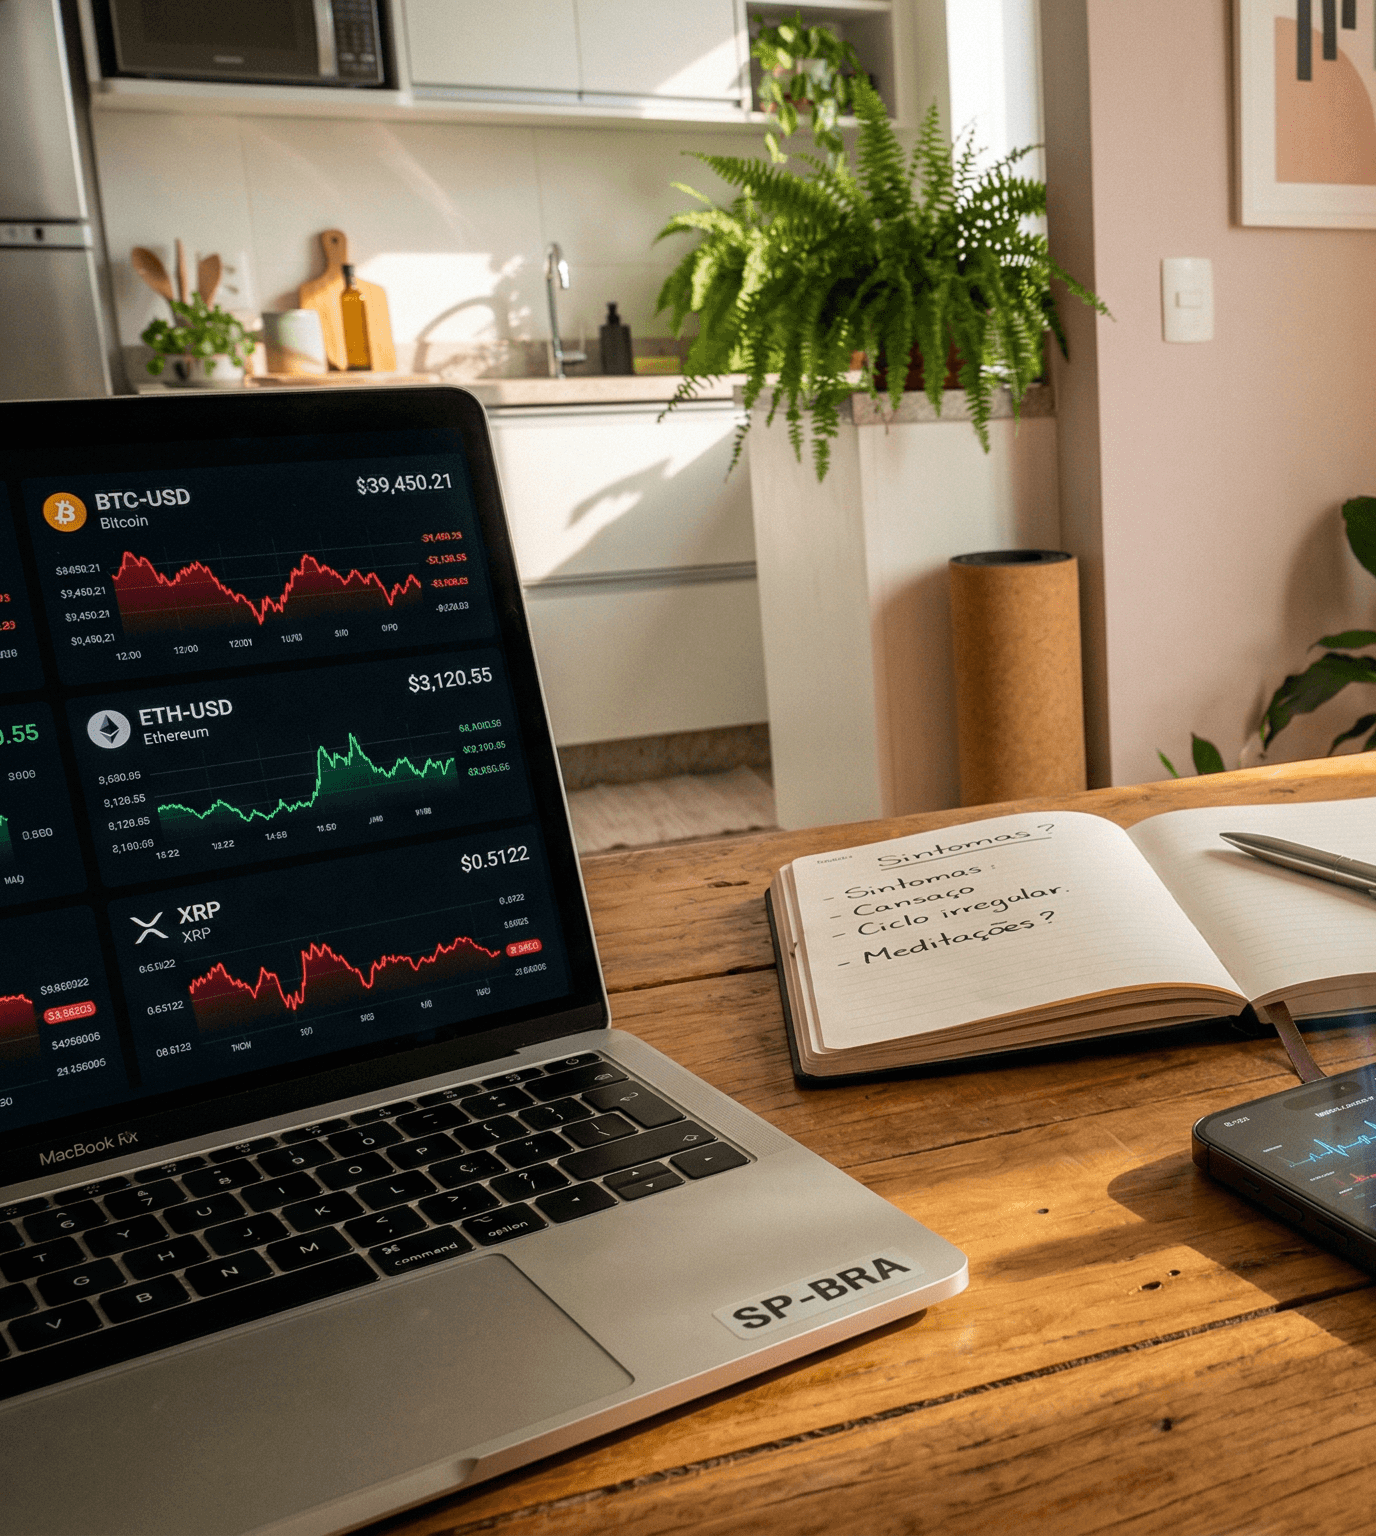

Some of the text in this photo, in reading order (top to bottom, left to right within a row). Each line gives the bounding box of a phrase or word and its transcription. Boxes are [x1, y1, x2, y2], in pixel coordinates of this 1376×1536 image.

[356, 472, 453, 495] $39,450.21
[95, 488, 191, 511] BTC-USD
[100, 514, 149, 530] Bitcoin
[408, 666, 493, 693] $3,120.55
[138, 698, 233, 726] ETH-USD
[143, 727, 210, 745] Ethereum
[877, 831, 1031, 867] Sintomas
[460, 845, 530, 873] $0.5122
[845, 866, 982, 899] Sintomas
[853, 887, 975, 916] Cansaço
[177, 900, 221, 924] XRP
[858, 915, 929, 935] Ciclo
[182, 927, 211, 943] XRP
[864, 920, 1035, 964] Meditações
[39, 1136, 115, 1166] MacBook
[416, 1146, 428, 1155] P
[390, 1186, 404, 1194] L
[196, 1206, 212, 1216] U
[314, 1206, 331, 1216] K
[117, 1230, 130, 1238] Y
[488, 1220, 529, 1237] option
[157, 1251, 175, 1261] H
[299, 1242, 319, 1254] M
[394, 1242, 458, 1266] command
[33, 1253, 47, 1262] T
[221, 1266, 239, 1277] N
[73, 1276, 90, 1286] G
[136, 1293, 153, 1303] B
[733, 1257, 912, 1329] SP-BRA
[46, 1318, 62, 1329] V
